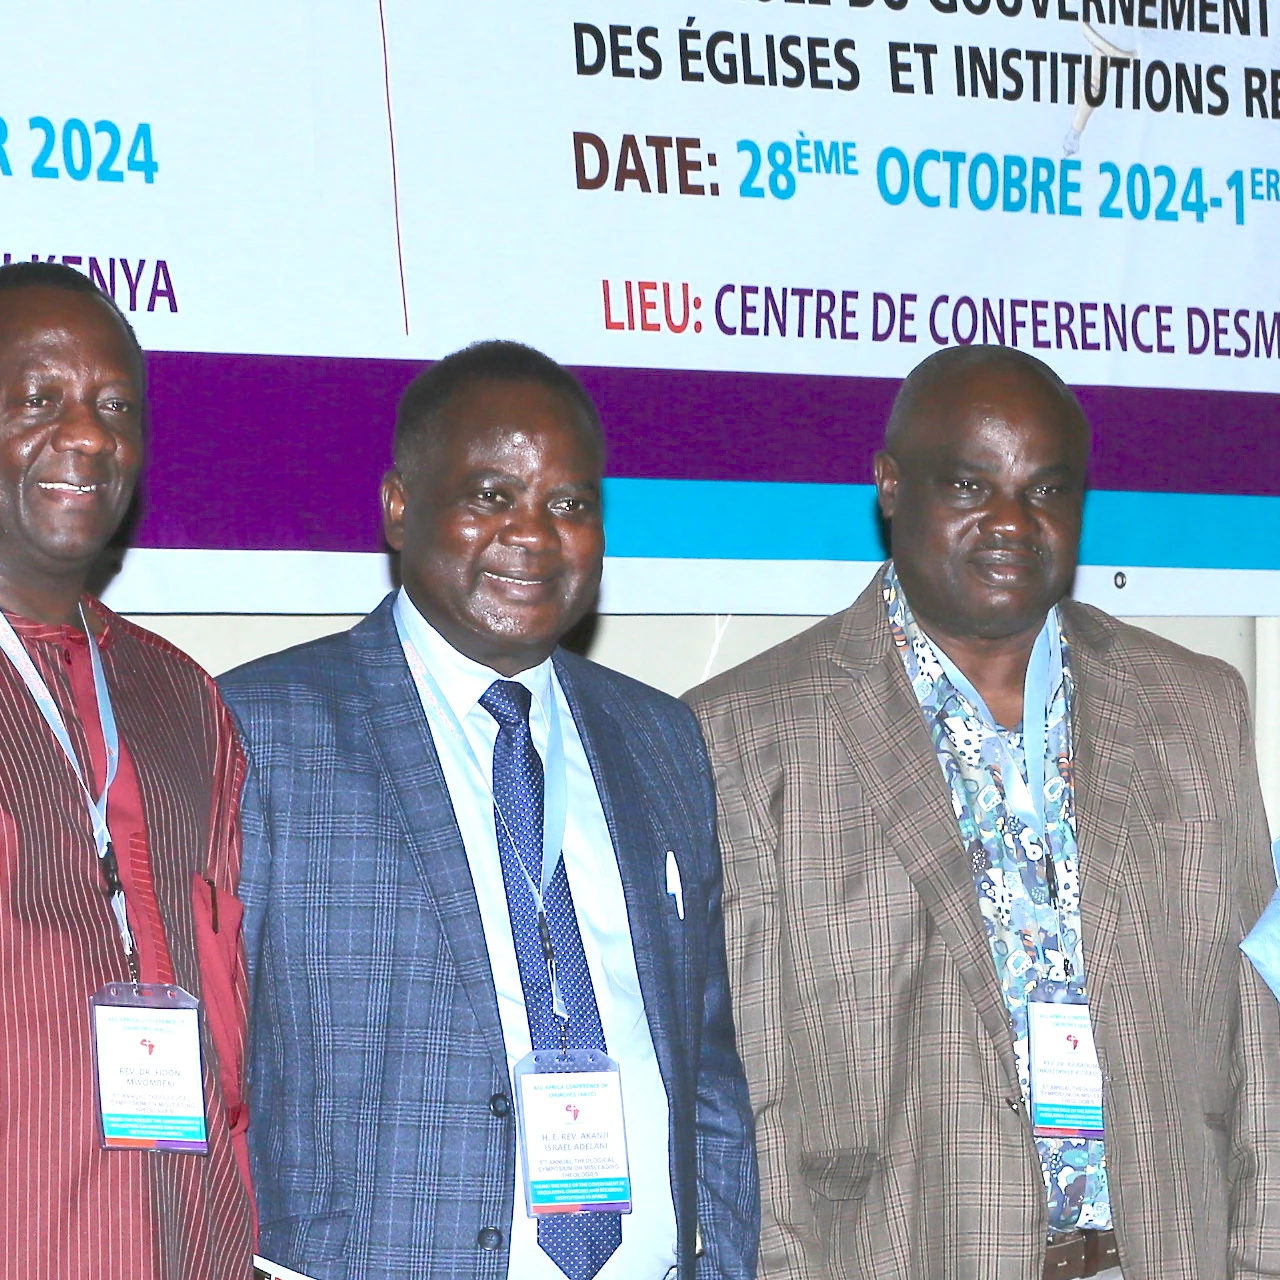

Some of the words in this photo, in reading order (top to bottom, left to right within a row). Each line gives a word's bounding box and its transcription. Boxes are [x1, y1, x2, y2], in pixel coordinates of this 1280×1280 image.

[574, 22, 662, 80] DES
[679, 16, 860, 91] ÉGLISES
[889, 42, 937, 95] ET
[954, 45, 1229, 116] INSTITUTIONS
[29, 116, 159, 184] 2024
[573, 132, 719, 196] DATE:
[876, 146, 1082, 216] OCTOBRE
[603, 280, 702, 333] LIEU:
[715, 284, 858, 340] CENTRE
[872, 292, 917, 343] DE
[930, 295, 1174, 354] CONFERENCE
[544, 1143, 572, 1152] ISRAEL
